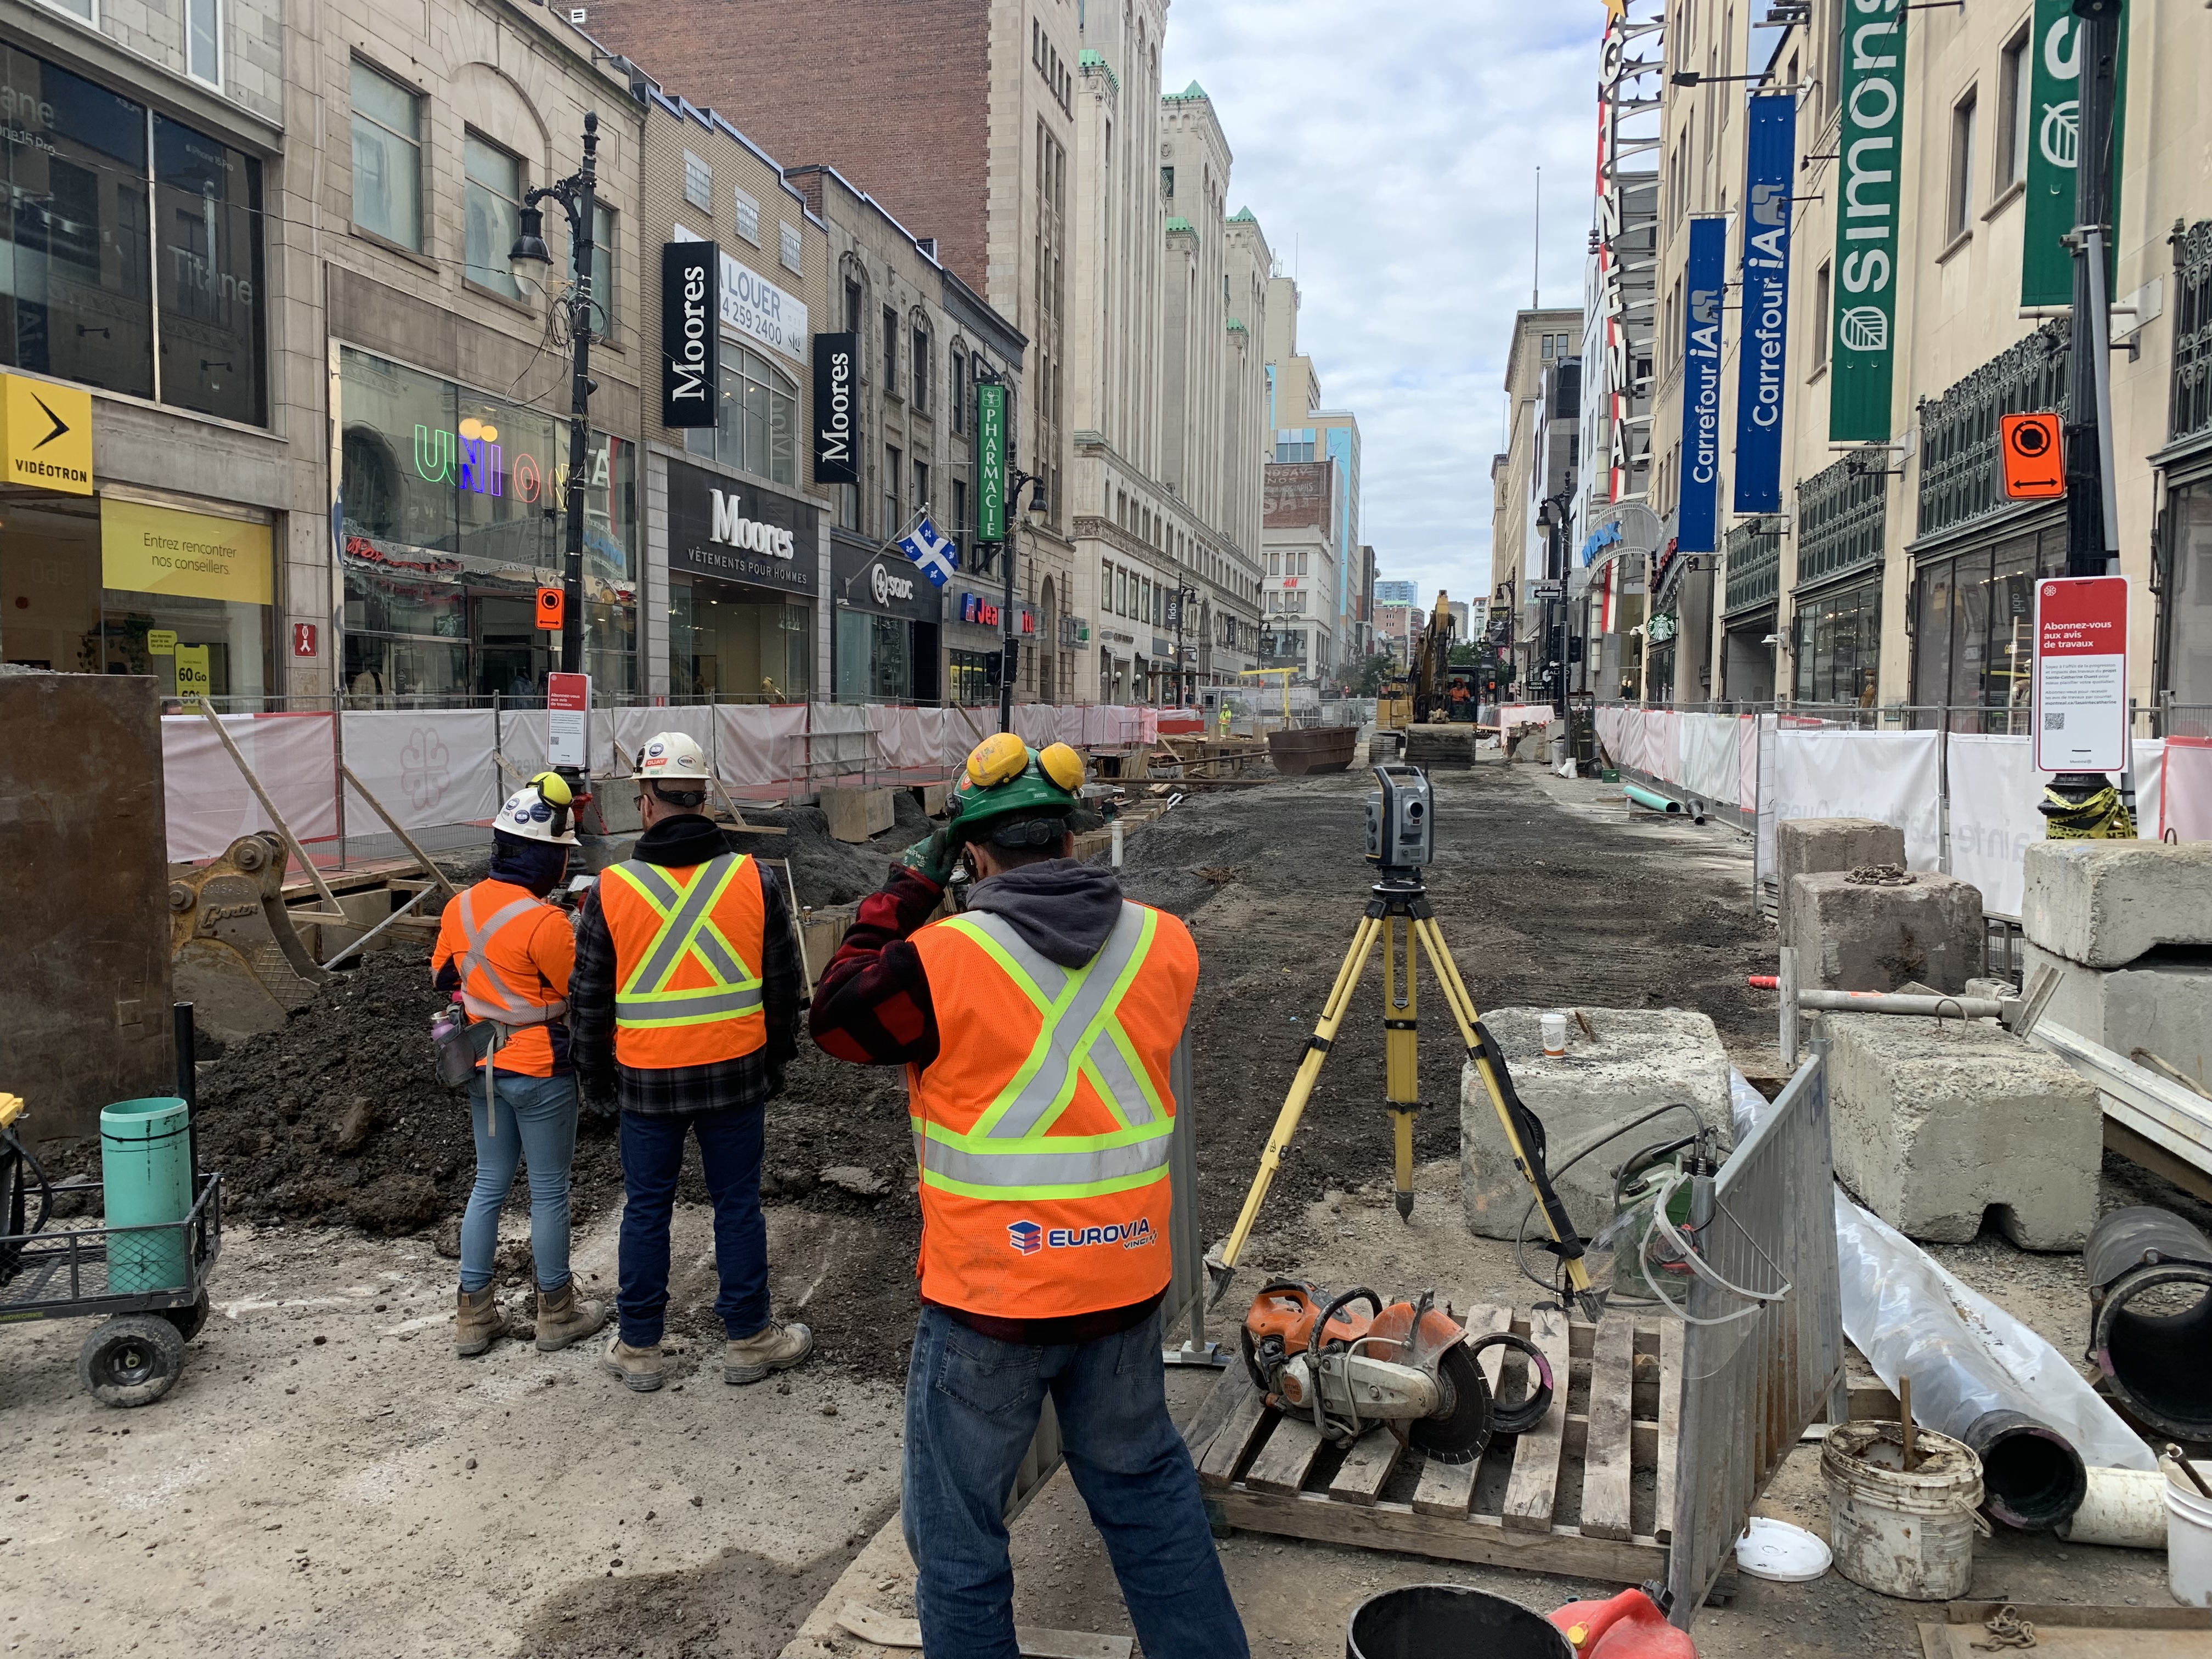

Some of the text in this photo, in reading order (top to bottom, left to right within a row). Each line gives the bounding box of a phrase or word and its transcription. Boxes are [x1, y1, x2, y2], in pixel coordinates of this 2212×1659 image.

[0, 86, 54, 129] ane
[166, 244, 253, 306] Titane
[729, 263, 781, 323] LOUER
[673, 266, 705, 402] Moores
[733, 301, 752, 329] 259
[755, 314, 782, 346] 2400
[1752, 275, 1785, 427] Carrefour
[822, 353, 849, 463] Moores
[1692, 363, 1718, 484] Carrefour
[15, 459, 87, 483] VIDÉOTRON
[983, 409, 998, 537] PHARMACIE
[1264, 469, 1307, 477] NDSAY
[709, 488, 794, 560] Moores
[143, 532, 237, 558] Entrez rencontrer
[151, 553, 173, 568] nos
[688, 546, 807, 584] VÊTEMENTS POUR HOMMES
[888, 575, 913, 601] SQDC
[977, 597, 998, 627] Jea
[1168, 602, 1177, 620] fido
[2044, 621, 2112, 630] Abonnez-vous
[2044, 640, 2056, 648] de
[2063, 630, 2082, 639] avis
[179, 667, 207, 682] 60 Go
[1049, 1218, 1150, 1246] EUROVIA
[1124, 1237, 1148, 1249] VINCI
